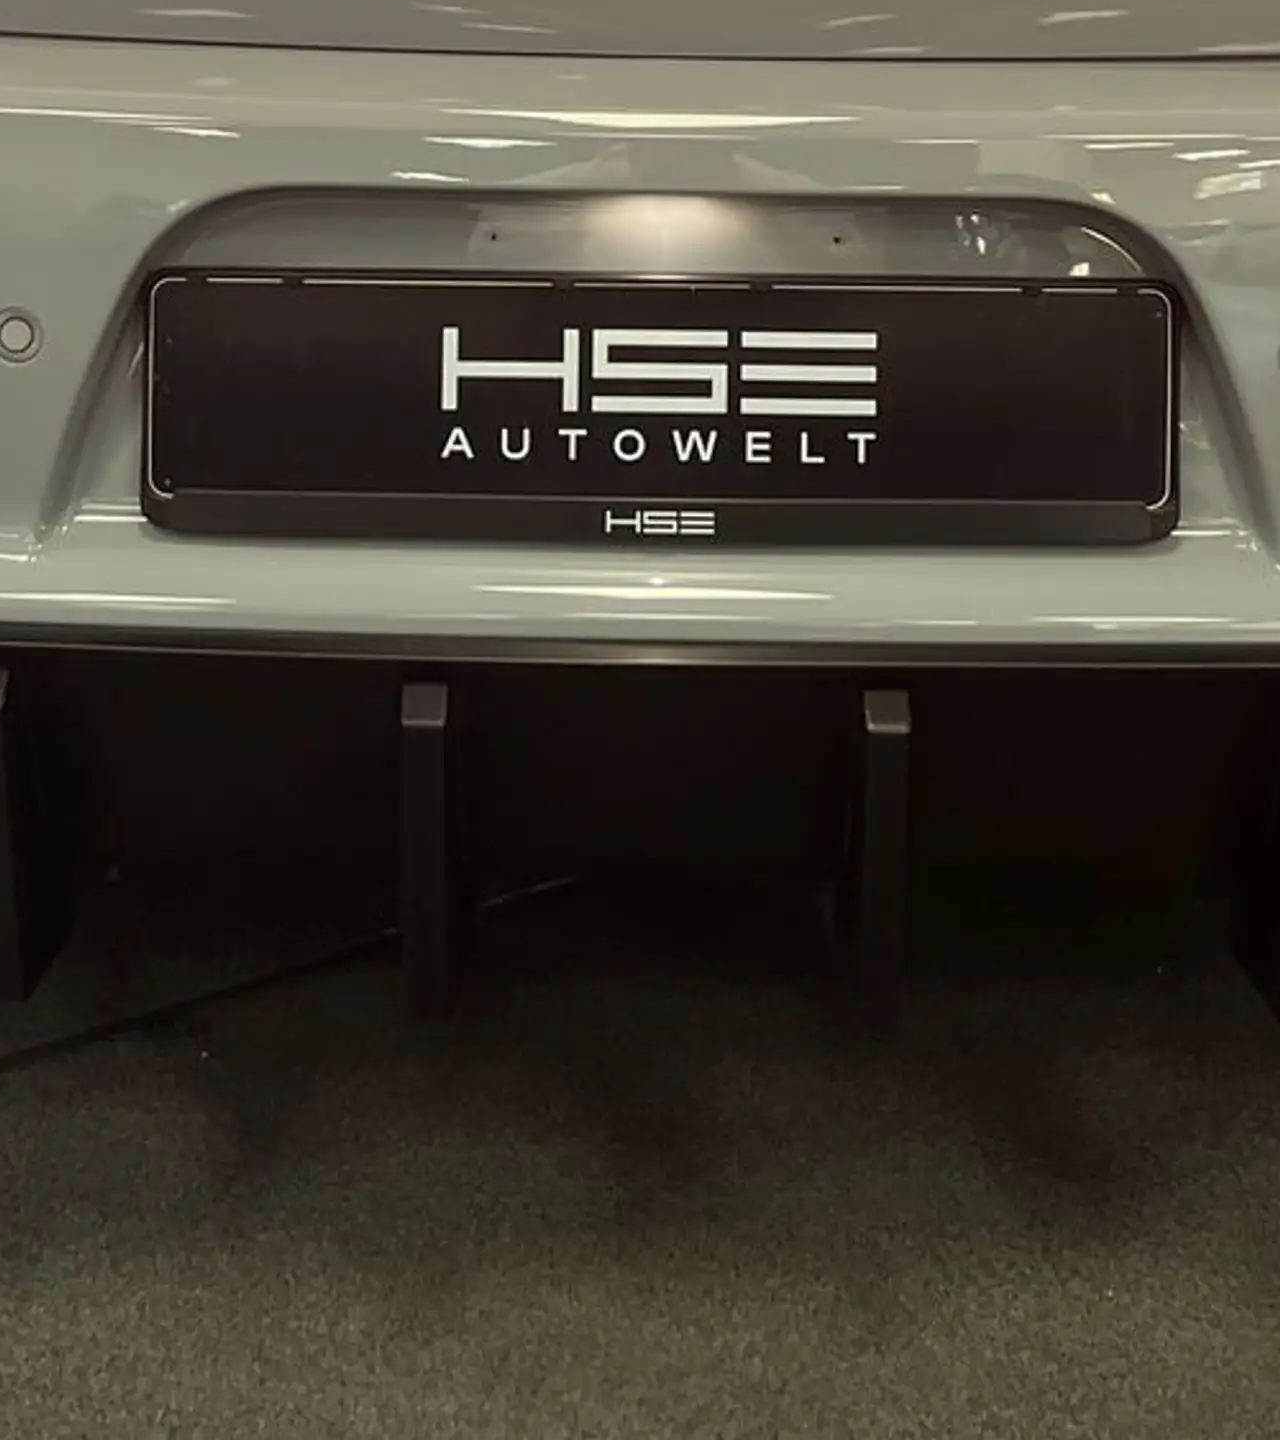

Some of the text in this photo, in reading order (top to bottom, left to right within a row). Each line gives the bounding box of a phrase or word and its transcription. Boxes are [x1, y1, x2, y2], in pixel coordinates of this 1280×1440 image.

[440, 326, 878, 417] HSE
[440, 426, 878, 464] AUTOWELT
[604, 509, 716, 536] HSE
